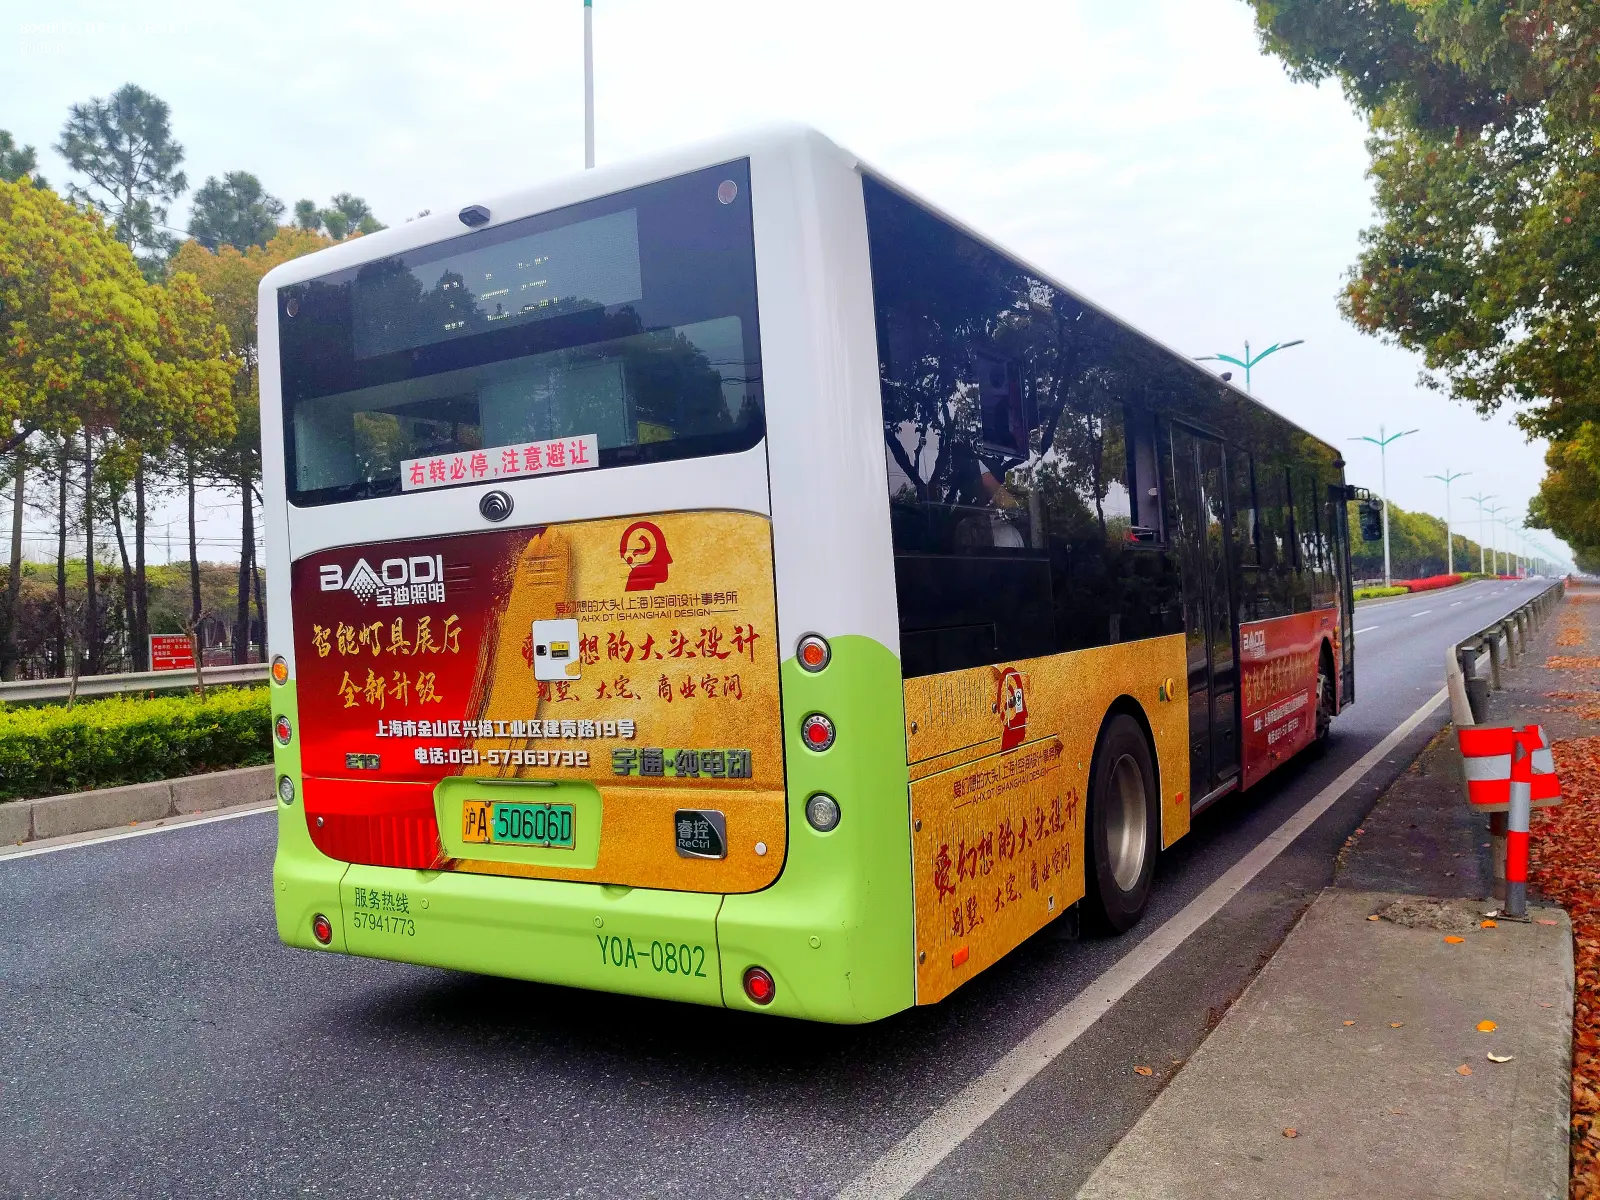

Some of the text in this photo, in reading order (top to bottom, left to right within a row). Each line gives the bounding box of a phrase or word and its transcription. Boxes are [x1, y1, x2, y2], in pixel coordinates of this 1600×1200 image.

[319, 554, 444, 592] BAODI
[376, 583, 446, 607] 宝迪照明
[580, 613, 615, 622] AHX.DT
[674, 609, 711, 618] DESIGN
[311, 614, 462, 657] 智能灯具展厅
[522, 623, 760, 667] 想的大头设计
[338, 668, 443, 711] 全新升级
[658, 674, 743, 703] 商业空间
[376, 720, 635, 738] 上海市金山区兴塔工业区建贡路19号
[678, 820, 709, 839] 睿控
[678, 839, 710, 849] ReCtrl
[935, 787, 1079, 904] 爱幻想的大头设计
[354, 887, 410, 914] 服务热线
[354, 912, 416, 937] 57941773
